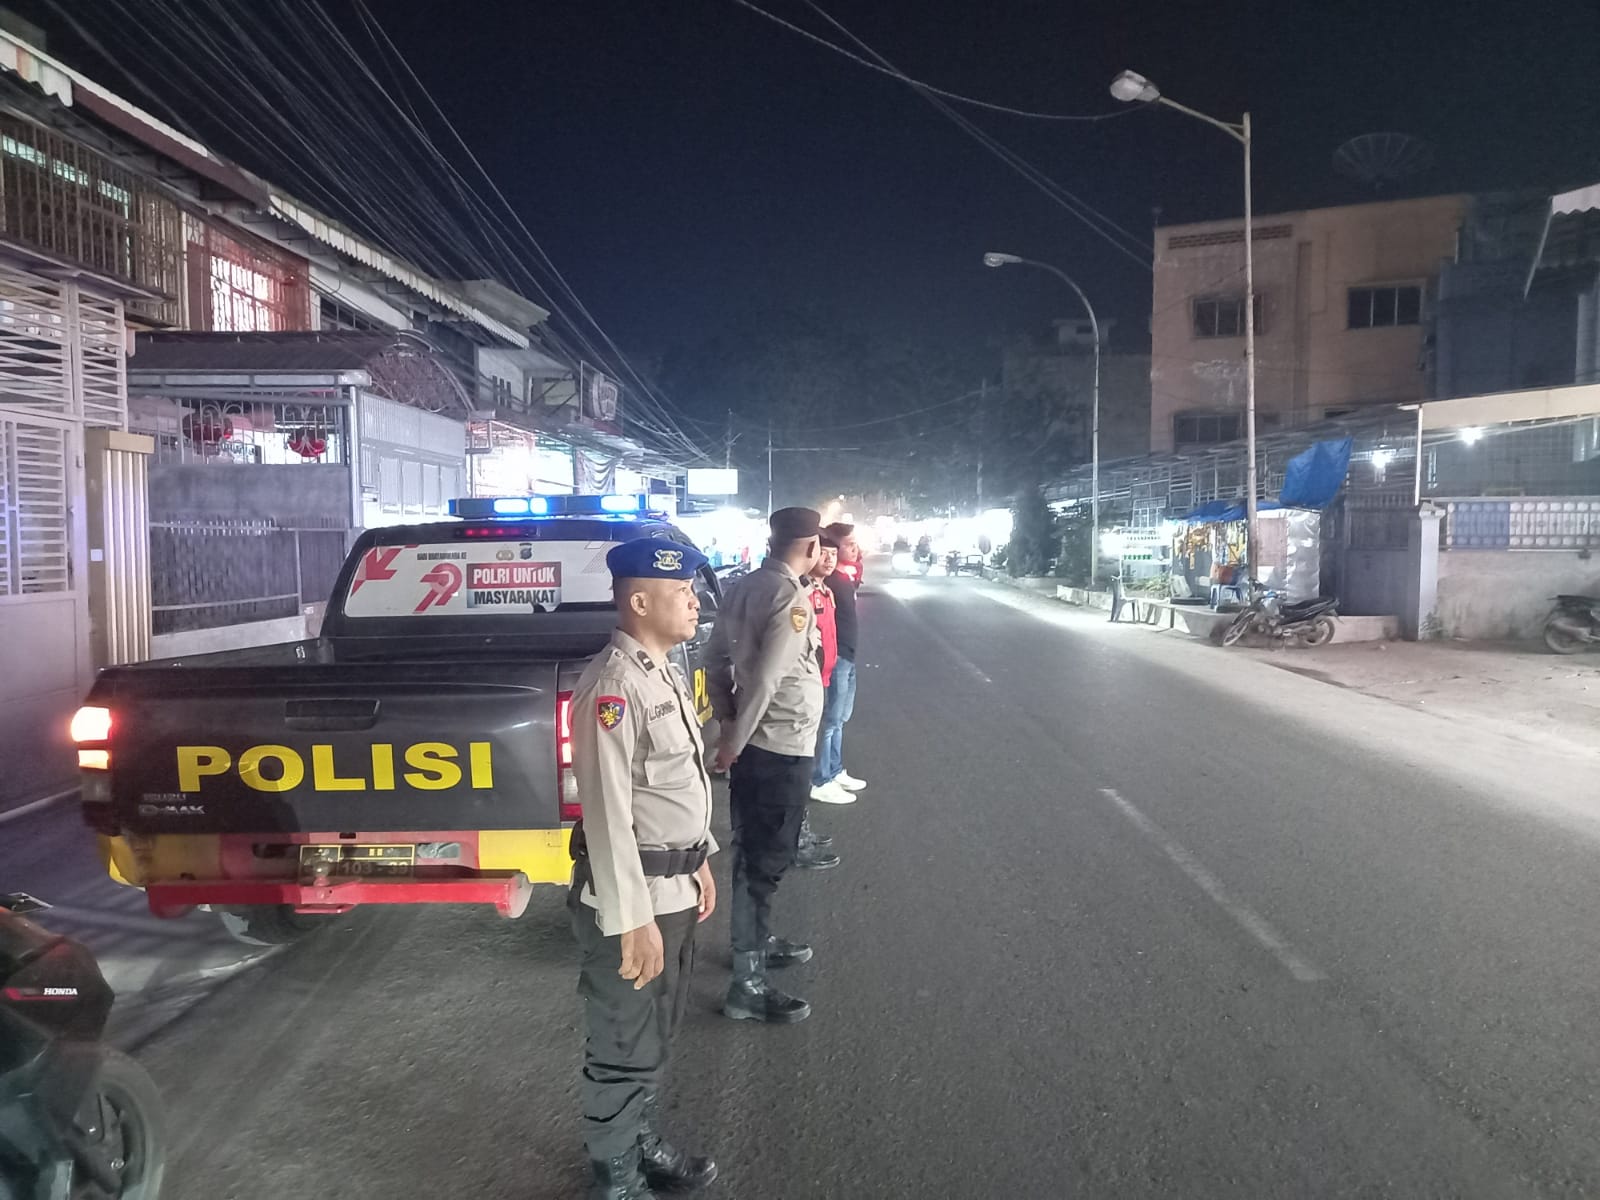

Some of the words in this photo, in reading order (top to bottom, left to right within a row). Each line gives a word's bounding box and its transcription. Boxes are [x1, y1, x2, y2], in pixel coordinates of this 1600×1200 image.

[473, 567, 509, 585] POLRI
[513, 566, 555, 583] UNTUK
[474, 589, 555, 605] MASYARAKAT
[176, 742, 493, 792] POLISI
[43, 987, 78, 996] HONDA
